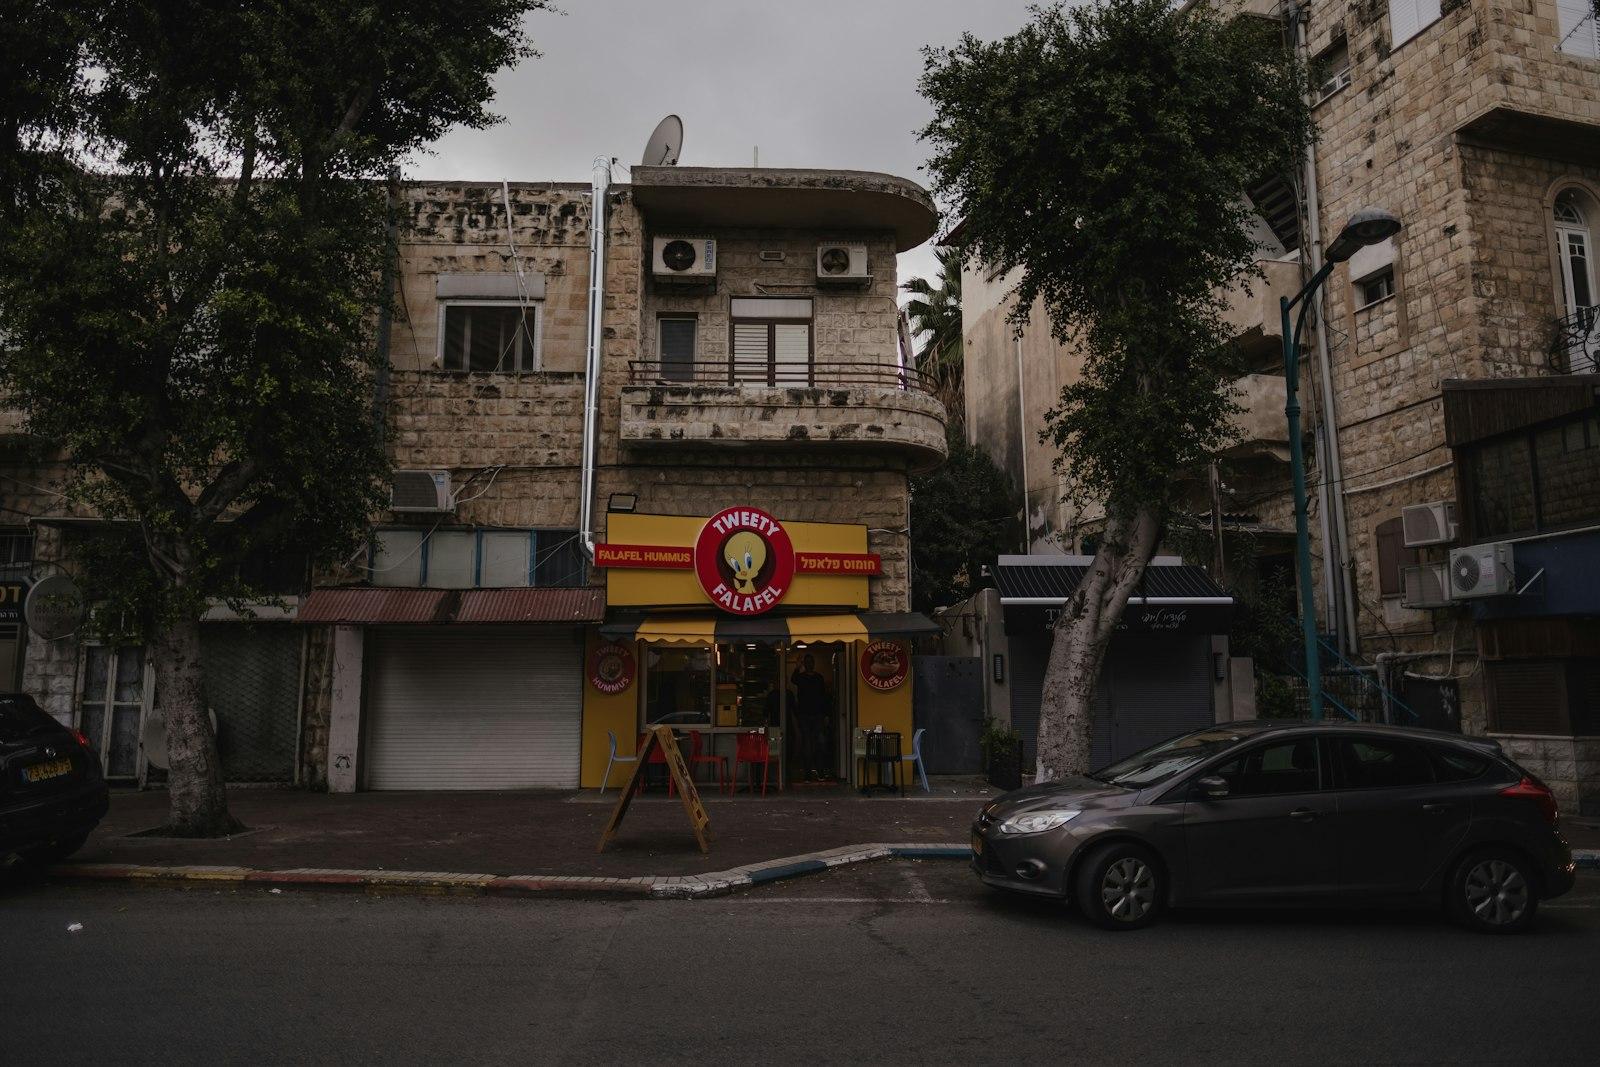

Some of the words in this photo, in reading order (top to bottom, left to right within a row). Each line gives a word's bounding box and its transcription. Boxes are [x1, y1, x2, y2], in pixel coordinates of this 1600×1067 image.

[712, 511, 780, 537] TWEETY
[598, 550, 642, 561] FALAFEL
[644, 552, 691, 562] HUMMUS
[801, 556, 840, 569] פלאפל
[843, 559, 876, 570] חומוס
[712, 583, 782, 611] FALAFEL
[595, 645, 631, 657] TWEETY
[867, 642, 902, 654] TWEETY
[592, 677, 629, 692] HUMMUS
[868, 675, 903, 688] FALAFEL
